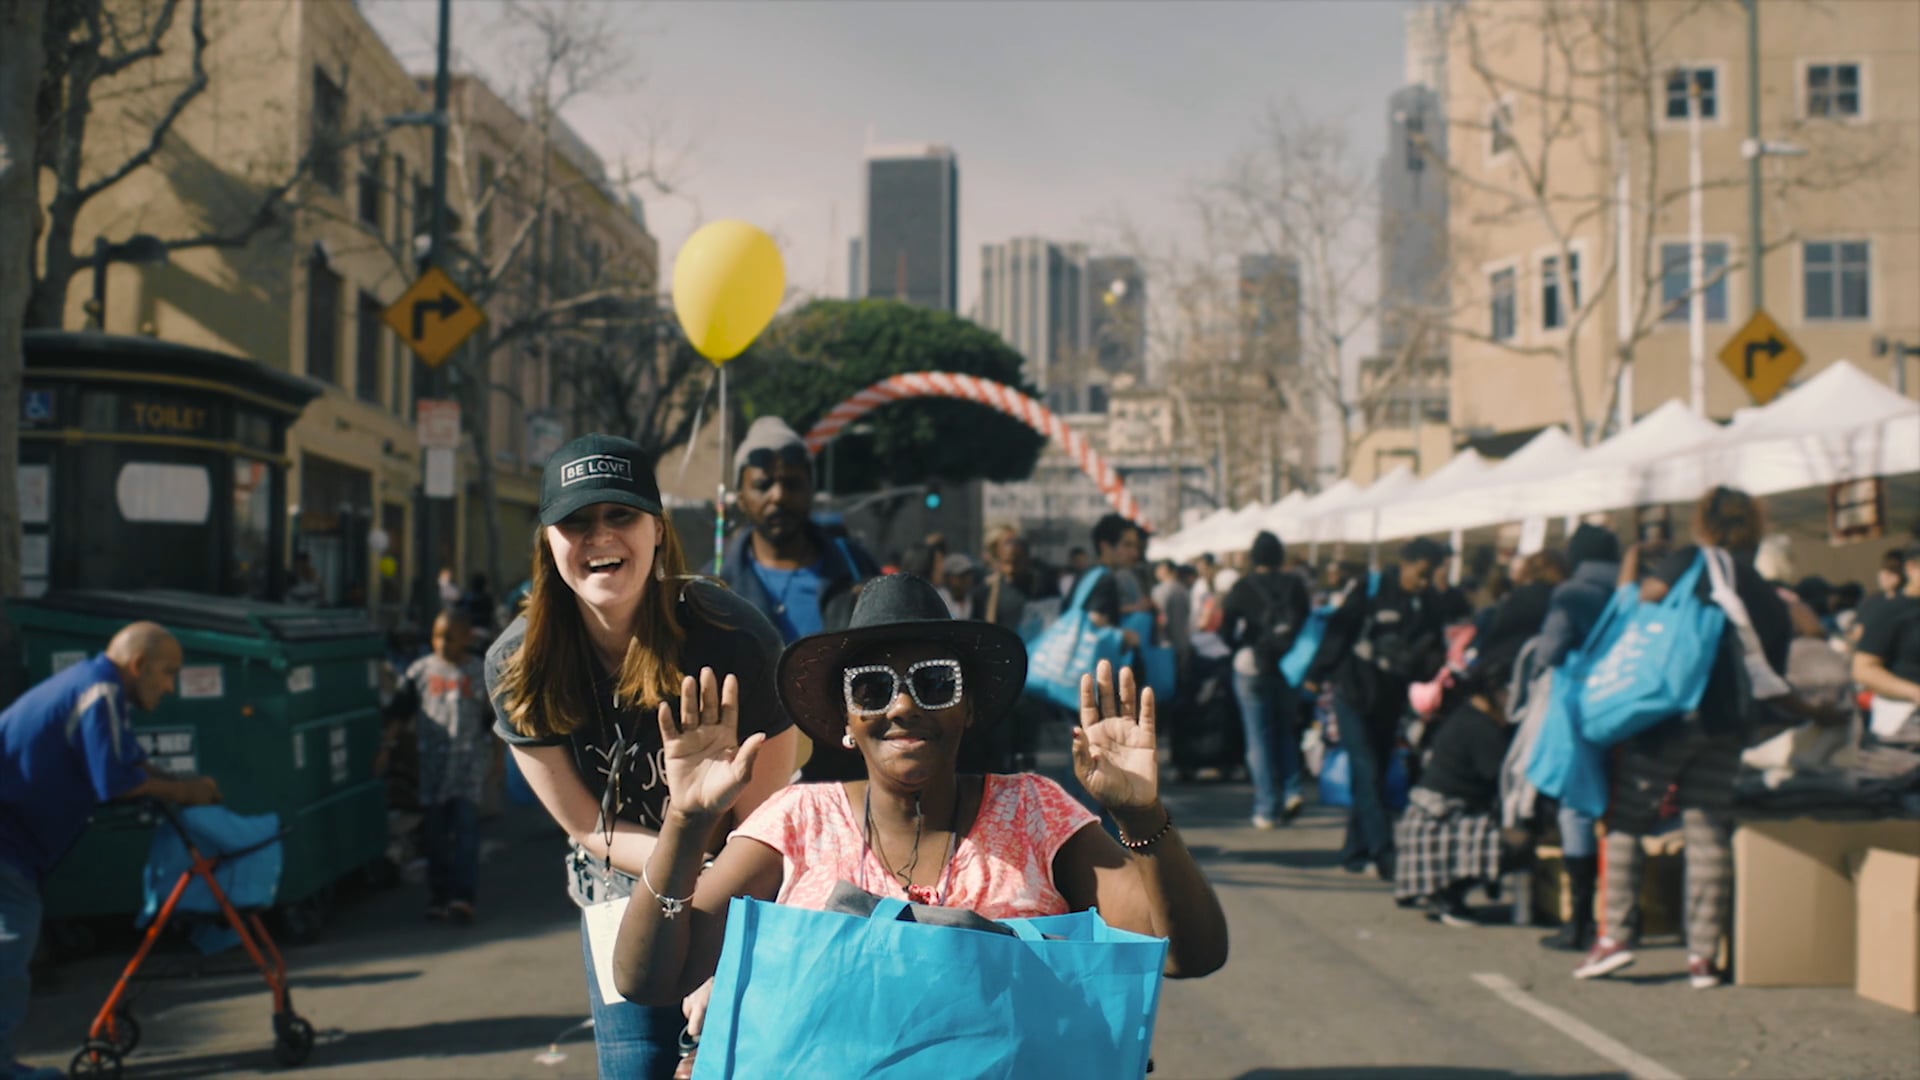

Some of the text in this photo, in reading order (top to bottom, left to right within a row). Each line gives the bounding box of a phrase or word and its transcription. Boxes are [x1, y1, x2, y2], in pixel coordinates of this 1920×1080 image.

[133, 403, 207, 430] TOILET
[567, 460, 625, 479] BE LOVE
